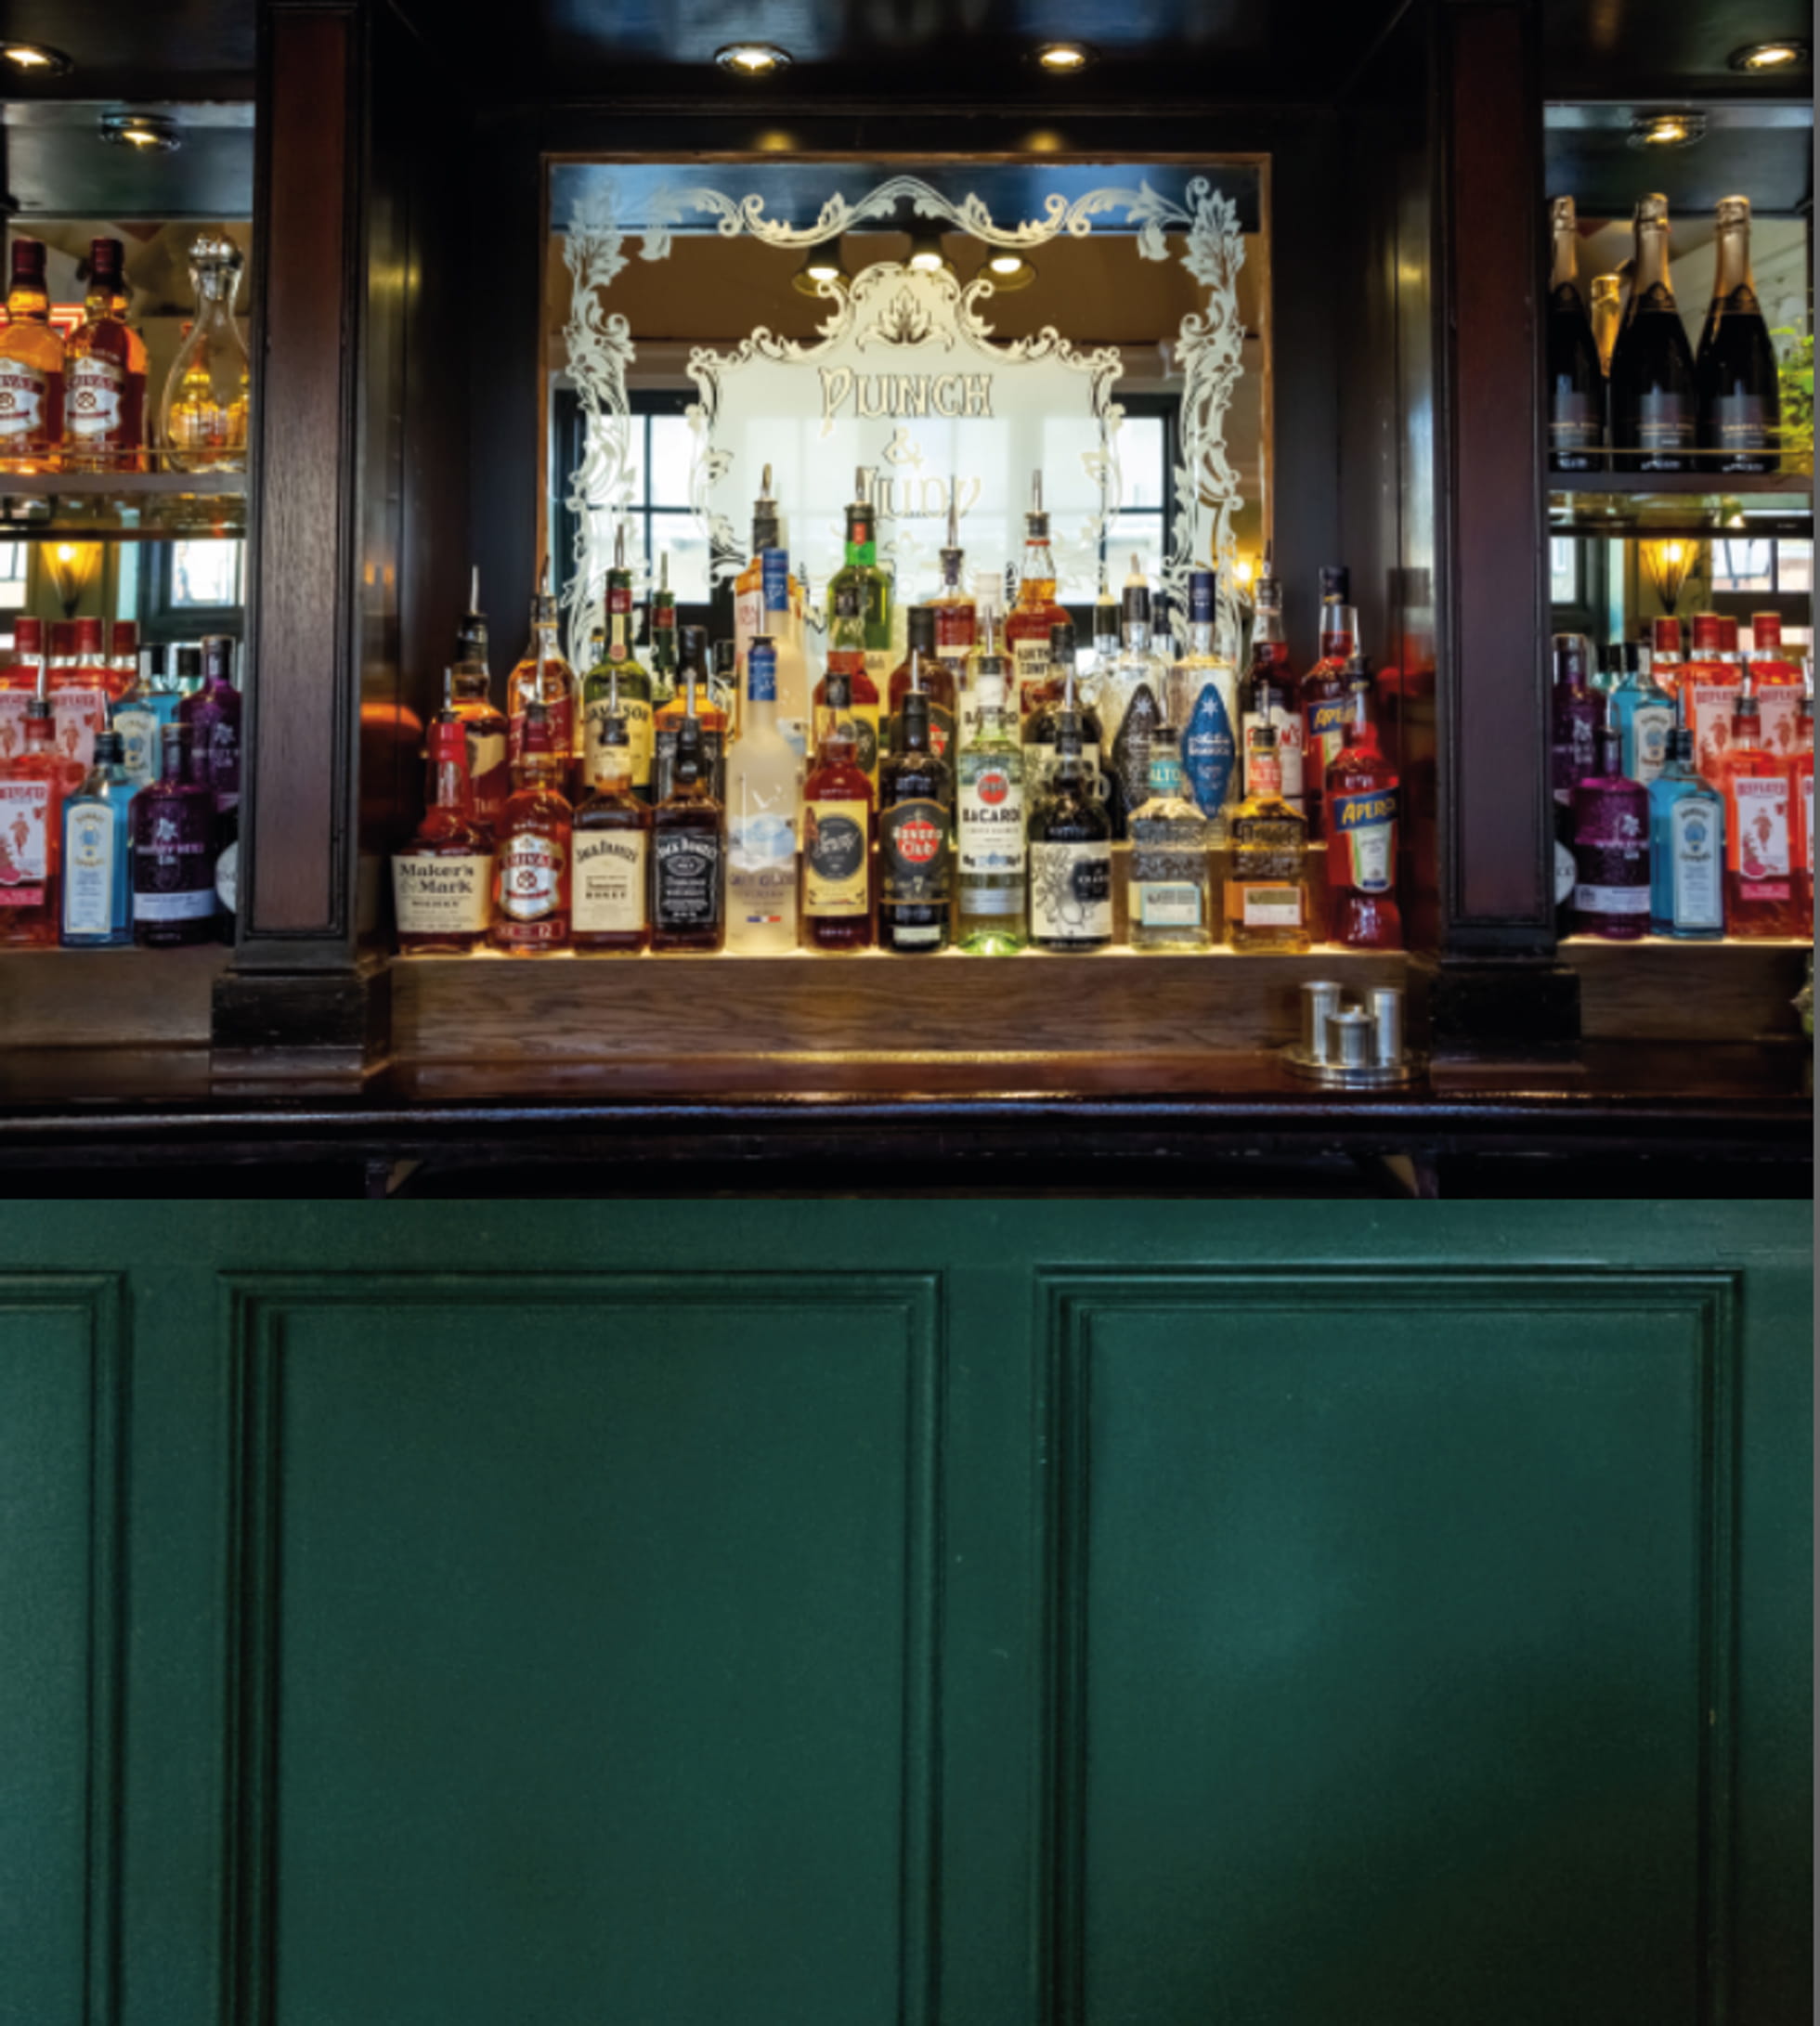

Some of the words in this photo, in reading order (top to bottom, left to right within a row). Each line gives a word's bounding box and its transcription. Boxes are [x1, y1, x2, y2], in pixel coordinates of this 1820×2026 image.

[818, 366, 994, 434] PUNCH
[882, 426, 924, 469] &
[398, 864, 474, 878] Maker's
[419, 880, 474, 894] Mark
